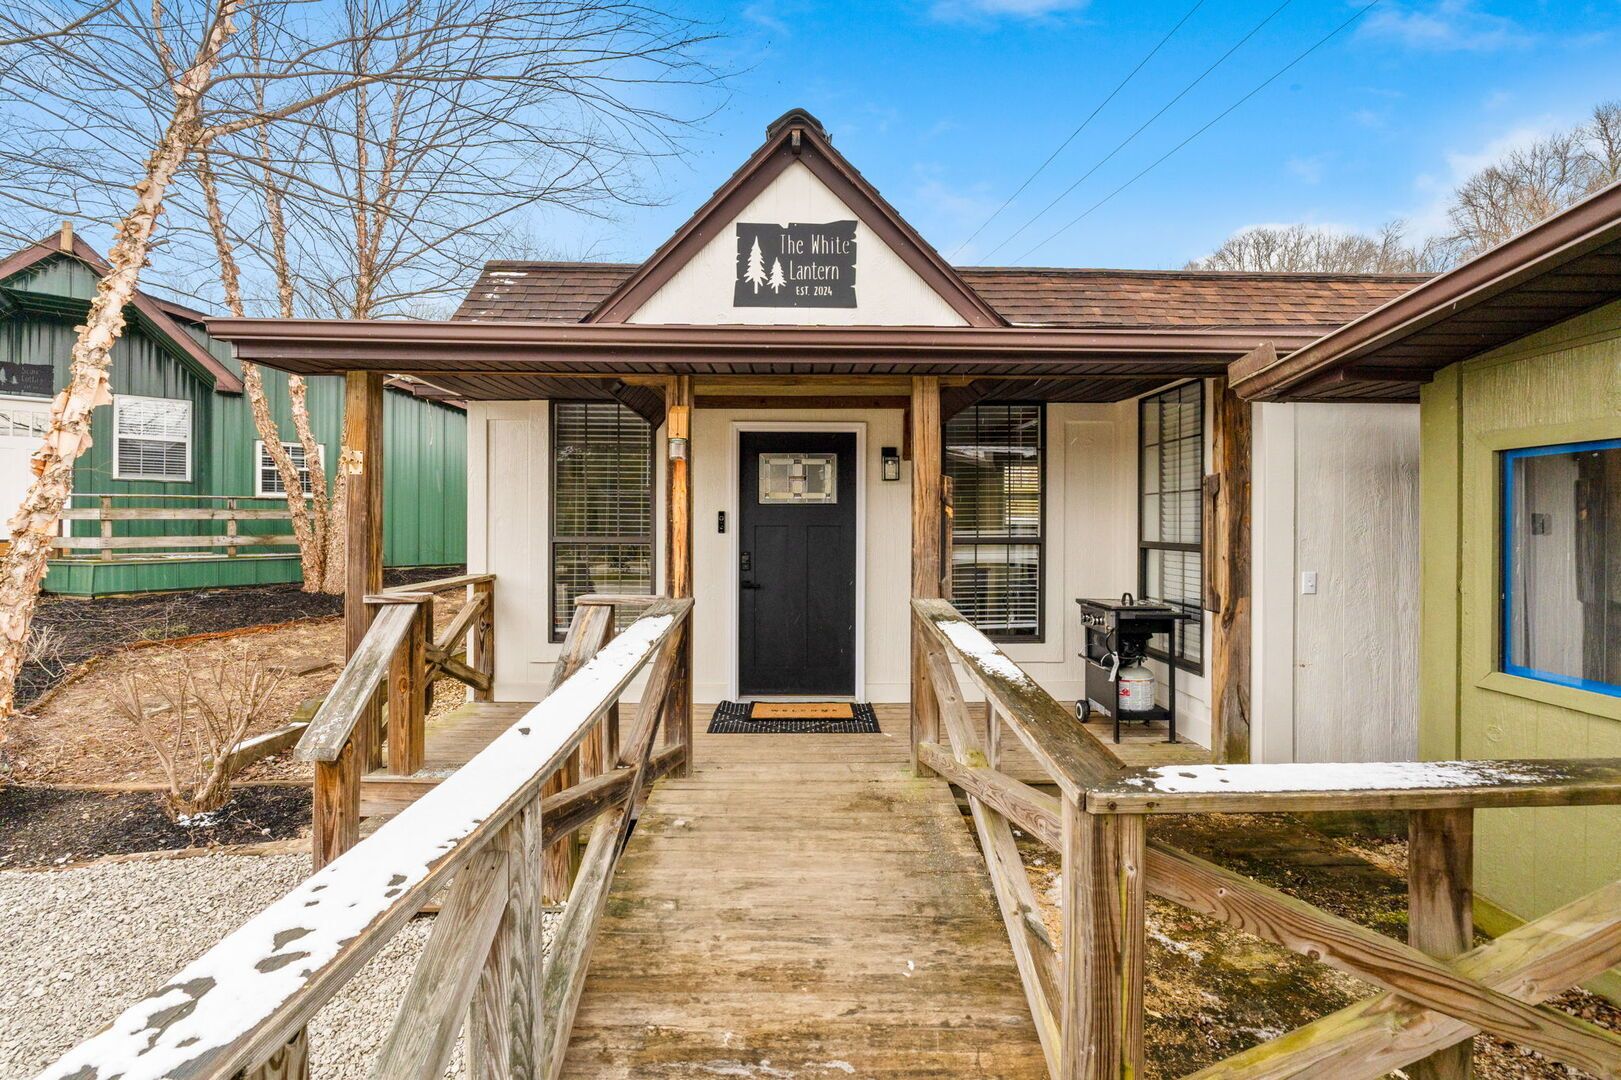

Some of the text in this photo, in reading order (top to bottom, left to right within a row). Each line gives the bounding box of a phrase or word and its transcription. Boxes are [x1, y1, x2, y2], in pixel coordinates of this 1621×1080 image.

[780, 234, 850, 254] The White
[789, 260, 839, 280] Lantern
[795, 286, 833, 296] EST. 2024
